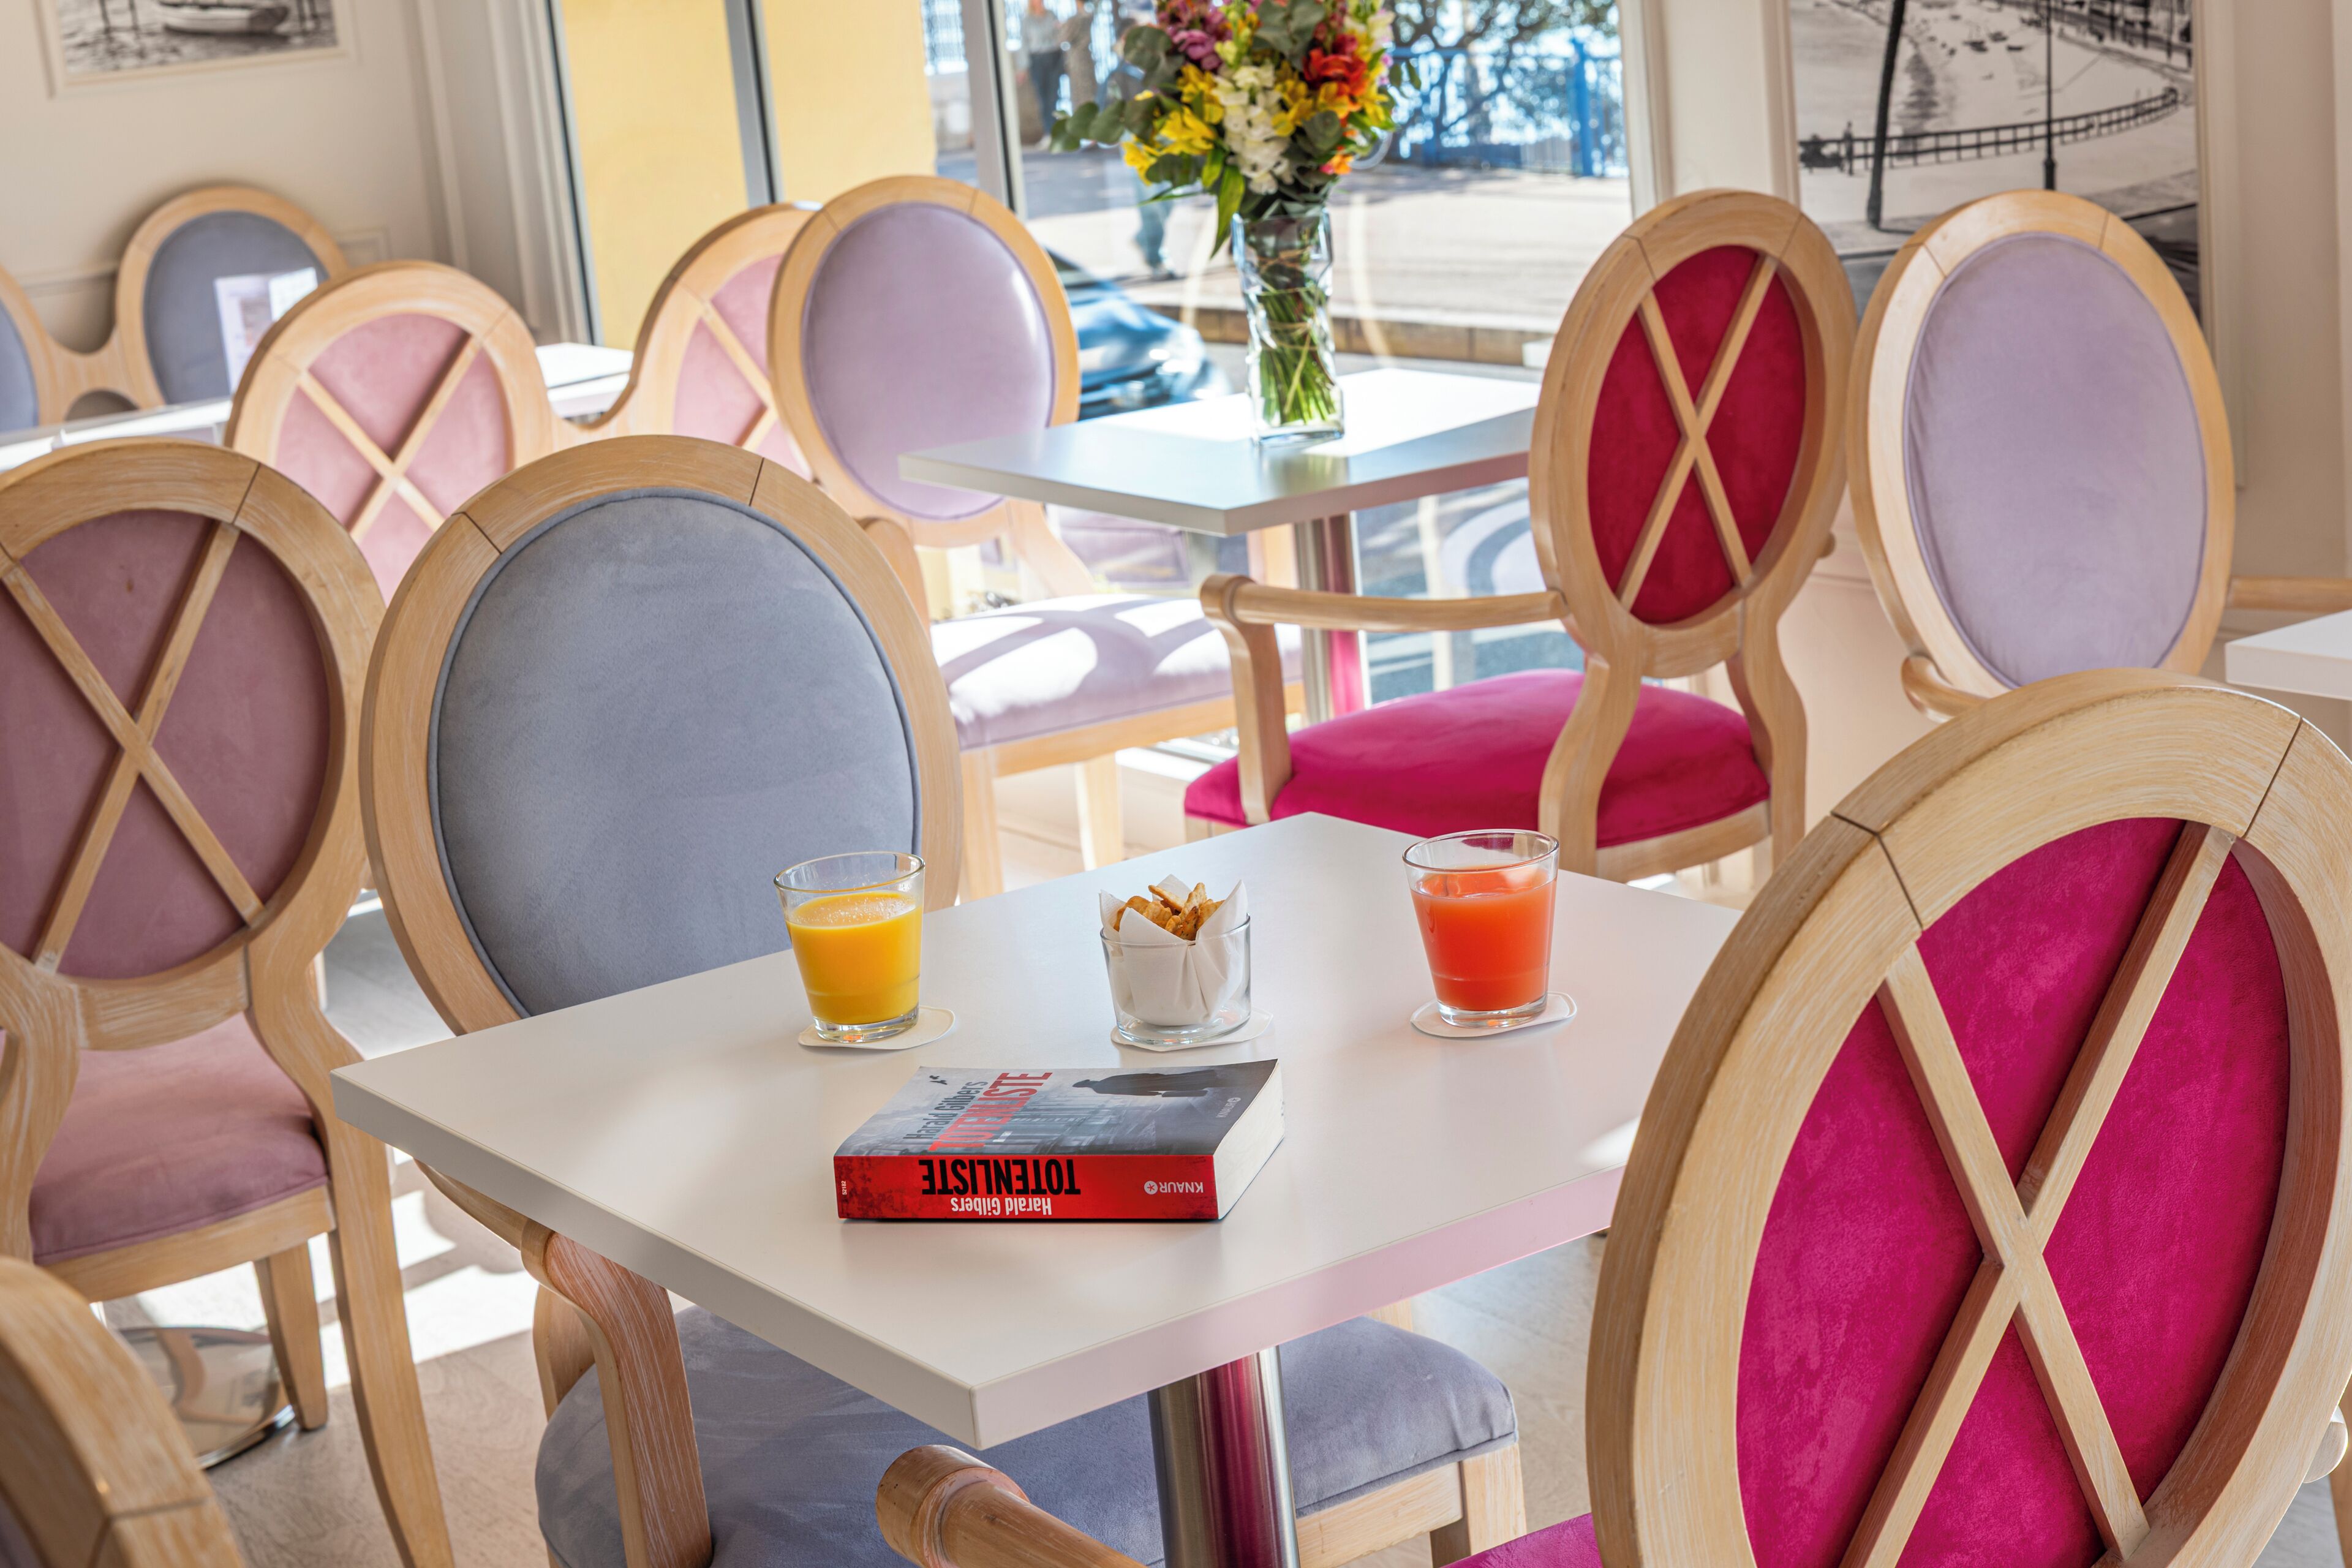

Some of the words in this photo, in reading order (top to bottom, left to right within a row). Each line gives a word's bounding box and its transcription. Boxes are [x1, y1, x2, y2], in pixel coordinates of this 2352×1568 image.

[903, 1113, 958, 1139] Harald
[934, 1082, 988, 1110] Gilbers
[928, 1072, 1053, 1151] TOTENLISTE
[1216, 1102, 1237, 1118] KNAUR
[919, 1159, 1080, 1195] TOTENLISTE
[1159, 1181, 1203, 1194] KNAUR
[951, 1197, 1000, 1216] Gilbers
[1005, 1197, 1052, 1216] Harald
